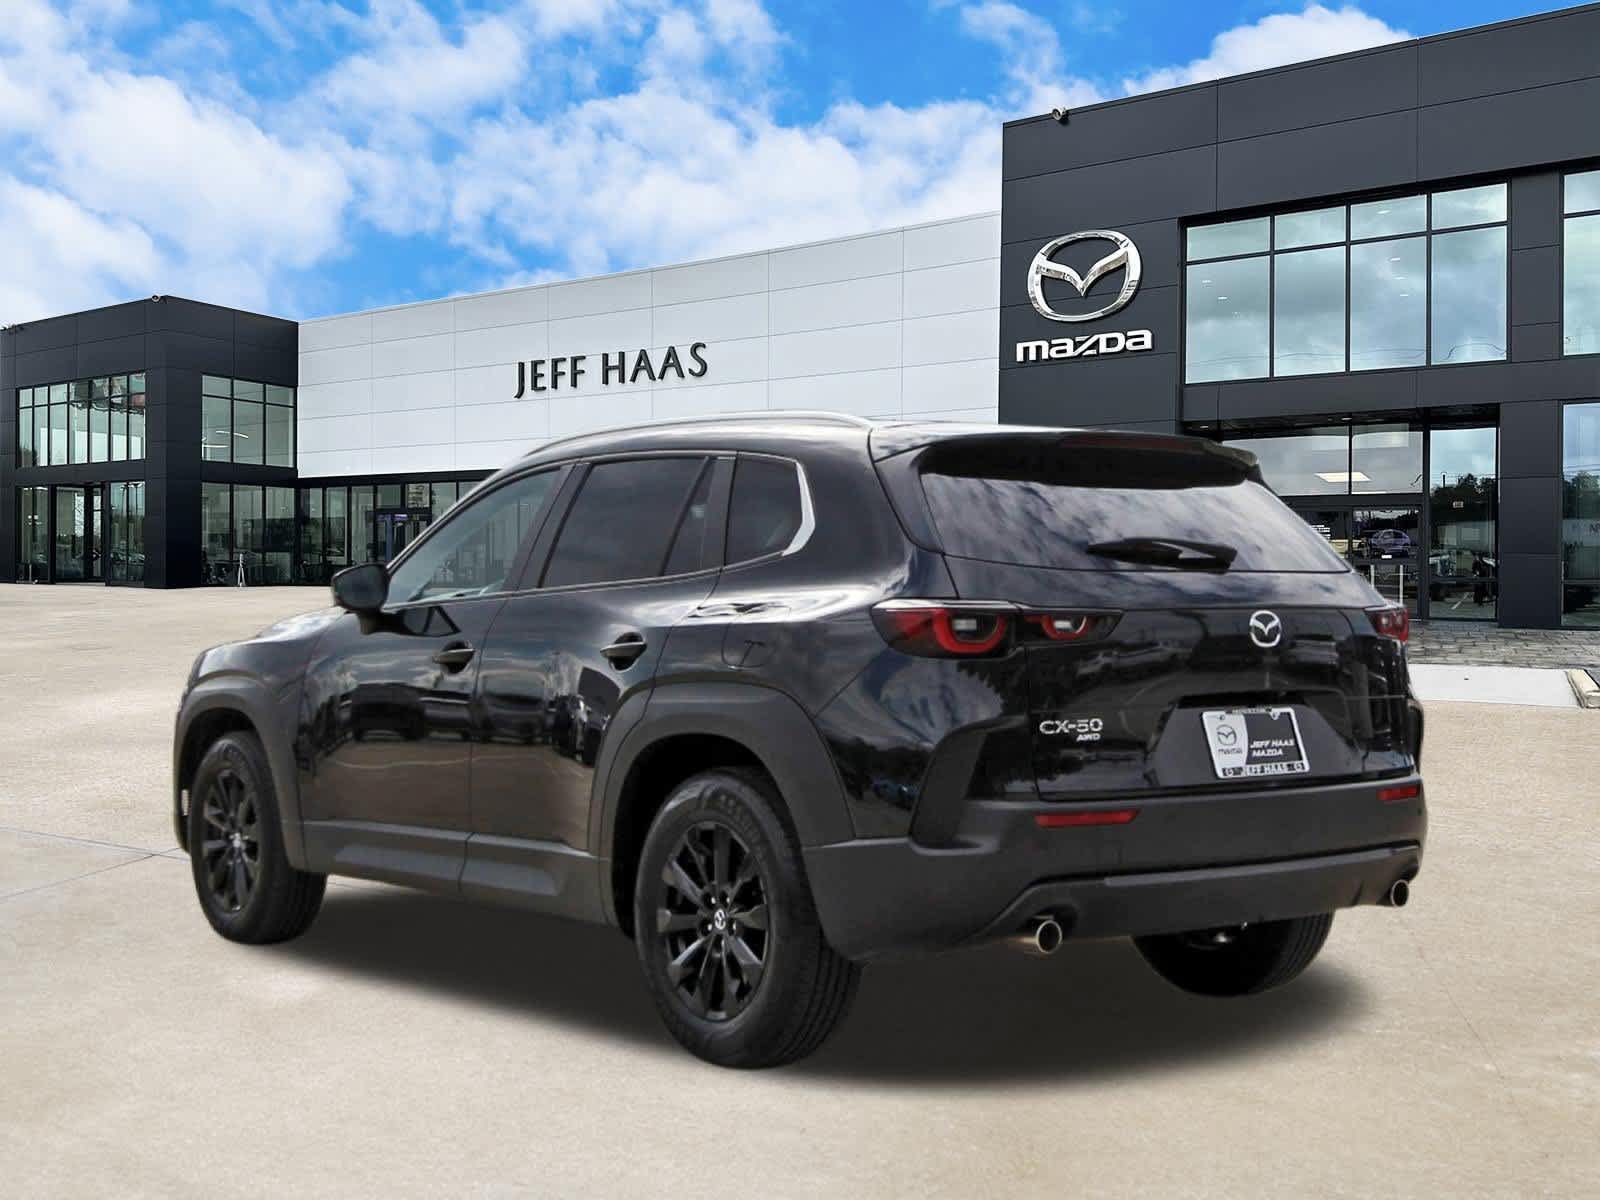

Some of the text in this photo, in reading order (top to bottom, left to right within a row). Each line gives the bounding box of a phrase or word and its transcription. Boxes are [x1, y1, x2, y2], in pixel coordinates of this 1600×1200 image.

[514, 342, 708, 399] JEFF HAAS
[1039, 718, 1104, 735] CX-50
